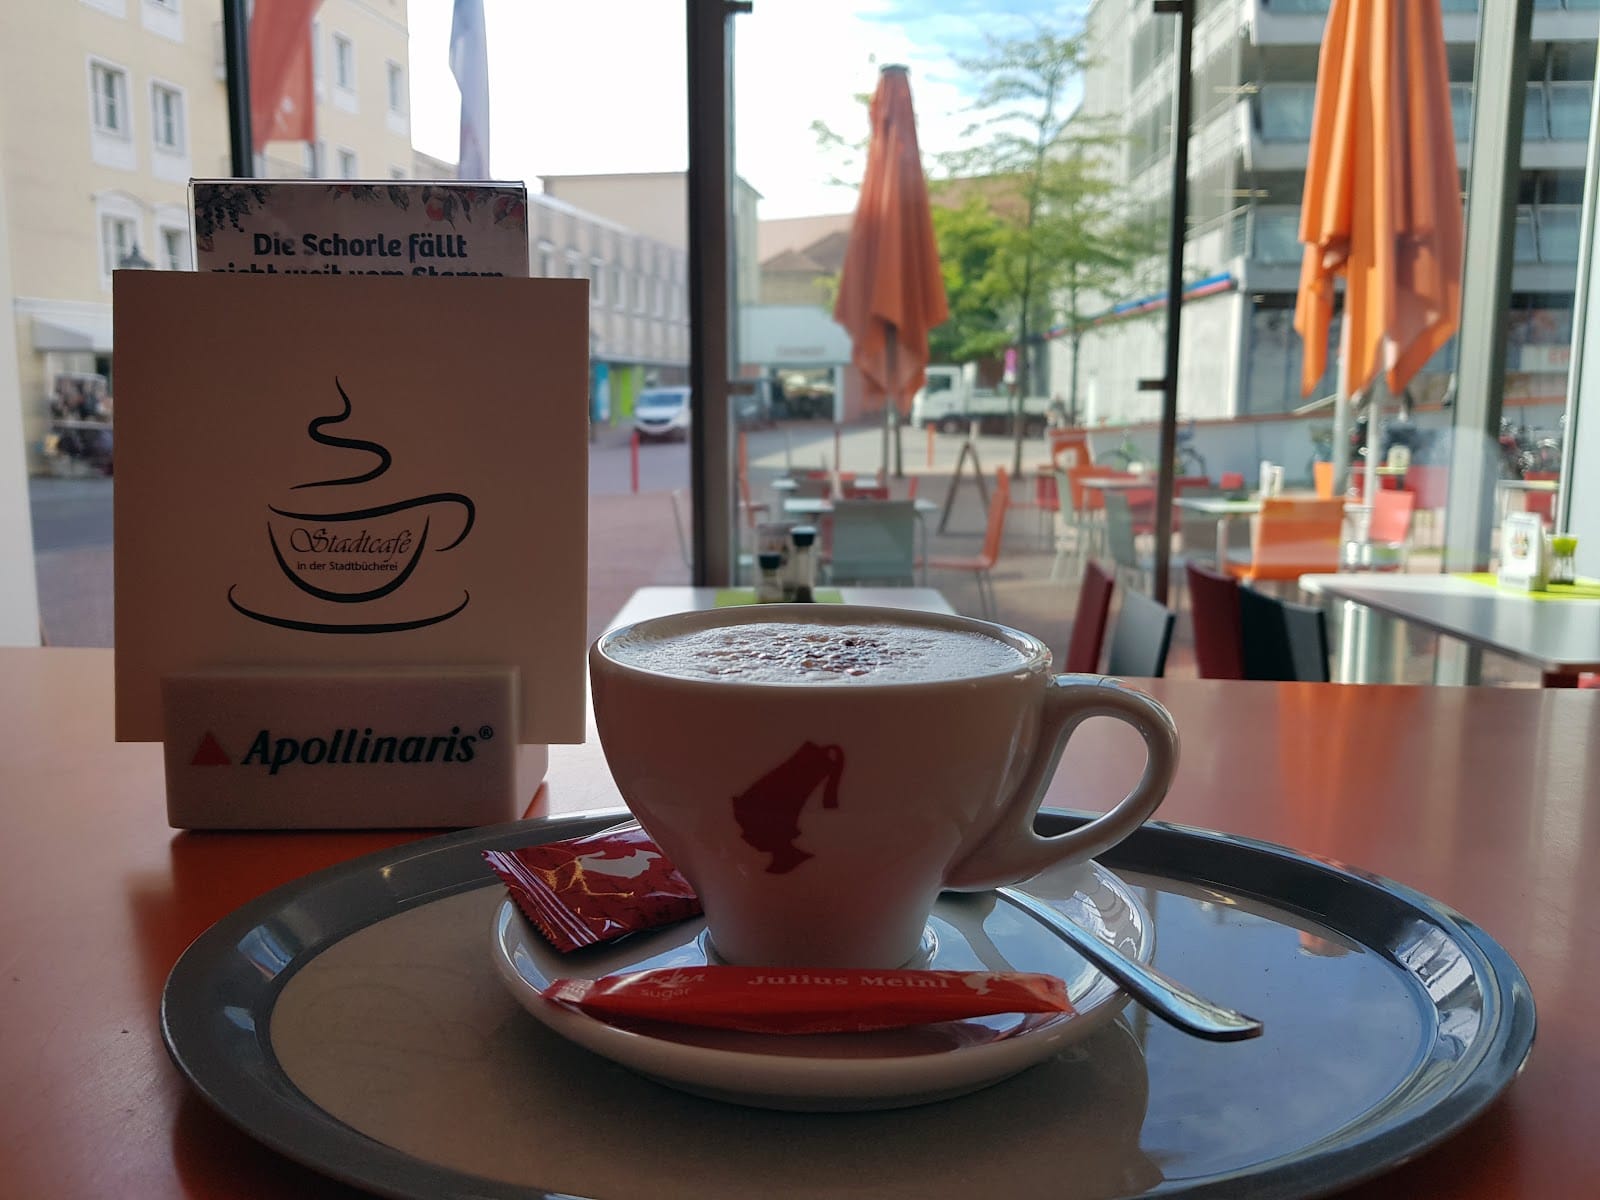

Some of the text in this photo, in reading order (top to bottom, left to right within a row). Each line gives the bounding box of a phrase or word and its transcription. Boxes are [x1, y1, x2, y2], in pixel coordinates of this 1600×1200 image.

[253, 232, 467, 263] Die Schorle fällt
[290, 528, 412, 562] Stadtcafé
[297, 561, 398, 571] in der Stadtbücherei
[748, 975, 949, 988] Julius Meinl
[640, 988, 691, 1000] sugar
